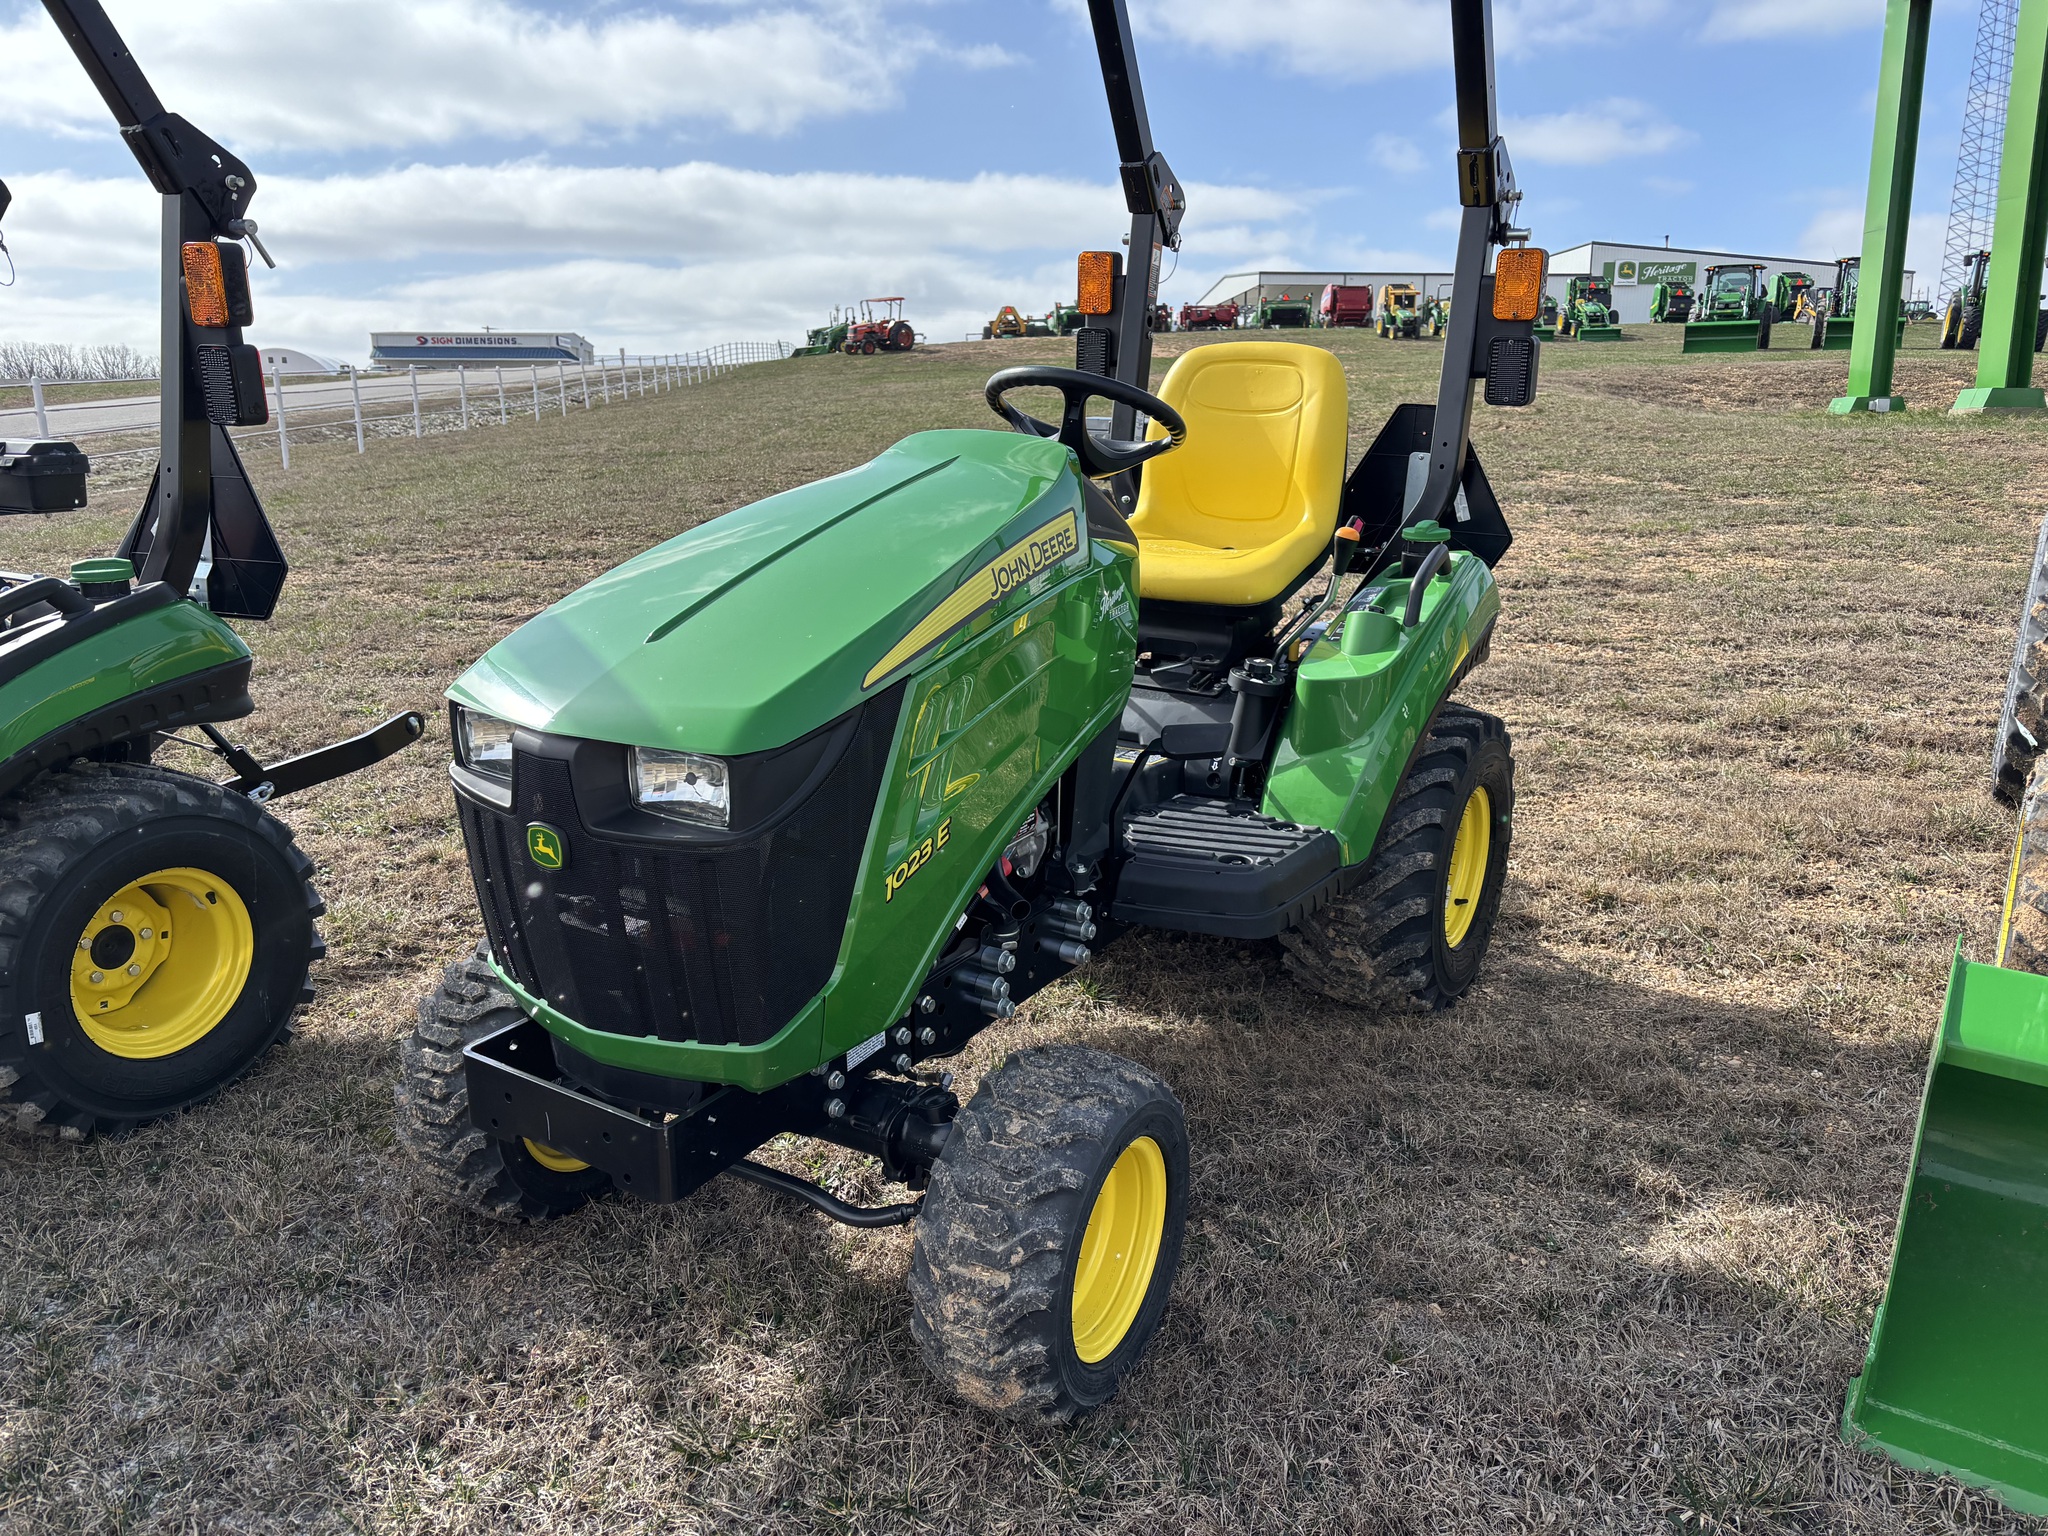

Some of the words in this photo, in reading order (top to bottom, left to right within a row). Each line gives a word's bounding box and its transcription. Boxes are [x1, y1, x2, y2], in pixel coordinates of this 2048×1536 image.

[1641, 263, 1687, 280] Heritage
[990, 555, 1031, 598] JOHN
[1029, 527, 1076, 571] DEERE
[884, 837, 934, 904] 1023
[936, 816, 952, 851] E
